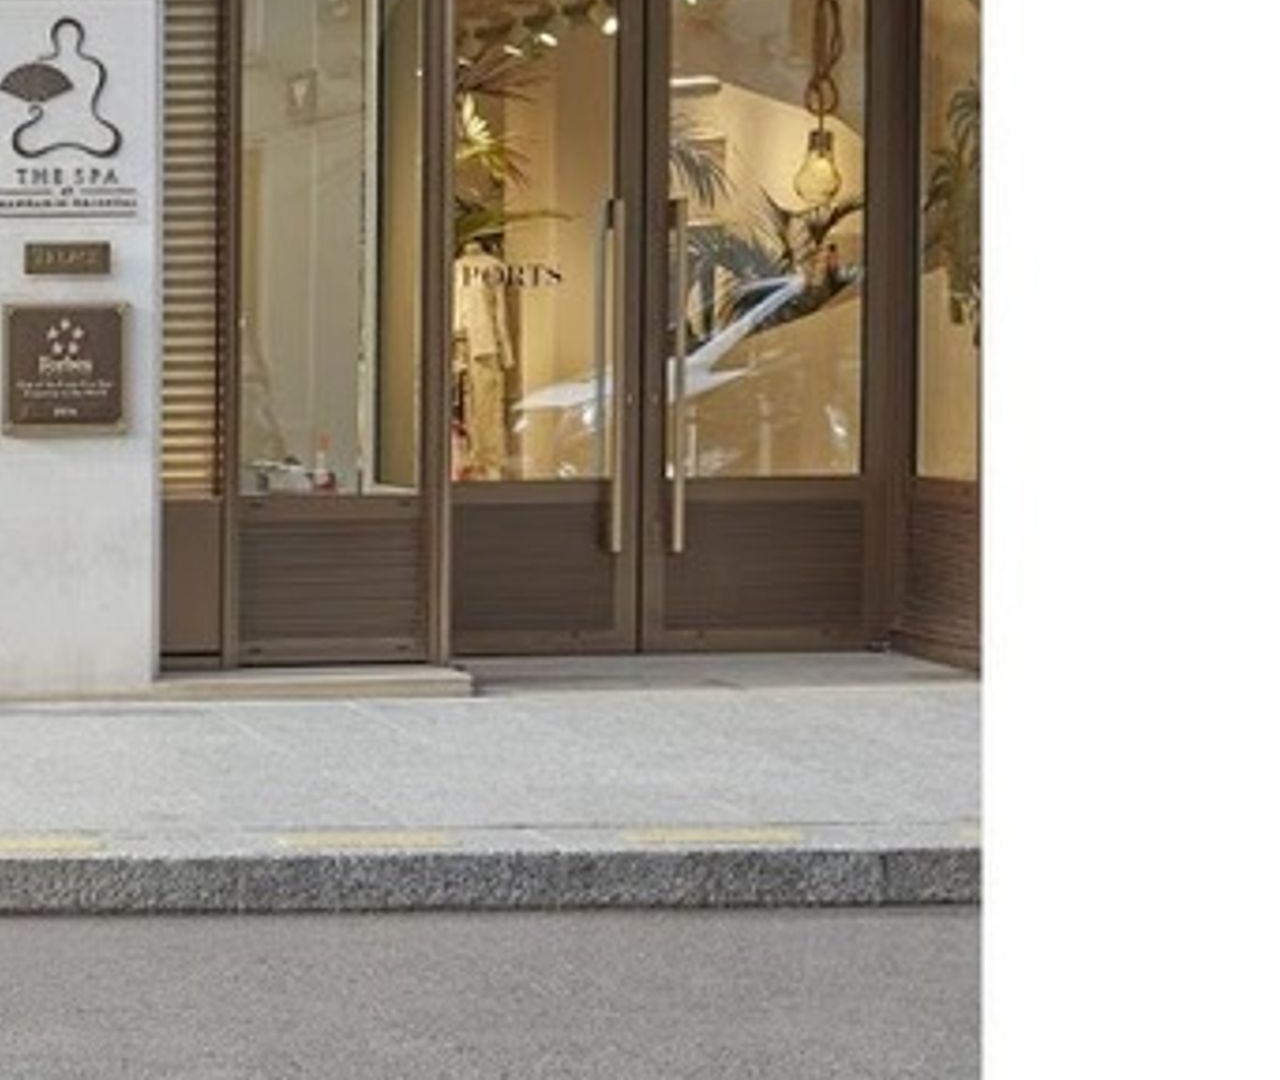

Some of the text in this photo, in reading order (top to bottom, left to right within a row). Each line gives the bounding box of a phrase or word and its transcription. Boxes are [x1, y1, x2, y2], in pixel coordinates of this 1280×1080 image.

[15, 167, 120, 185] THE SPA
[461, 262, 562, 288] PORTS
